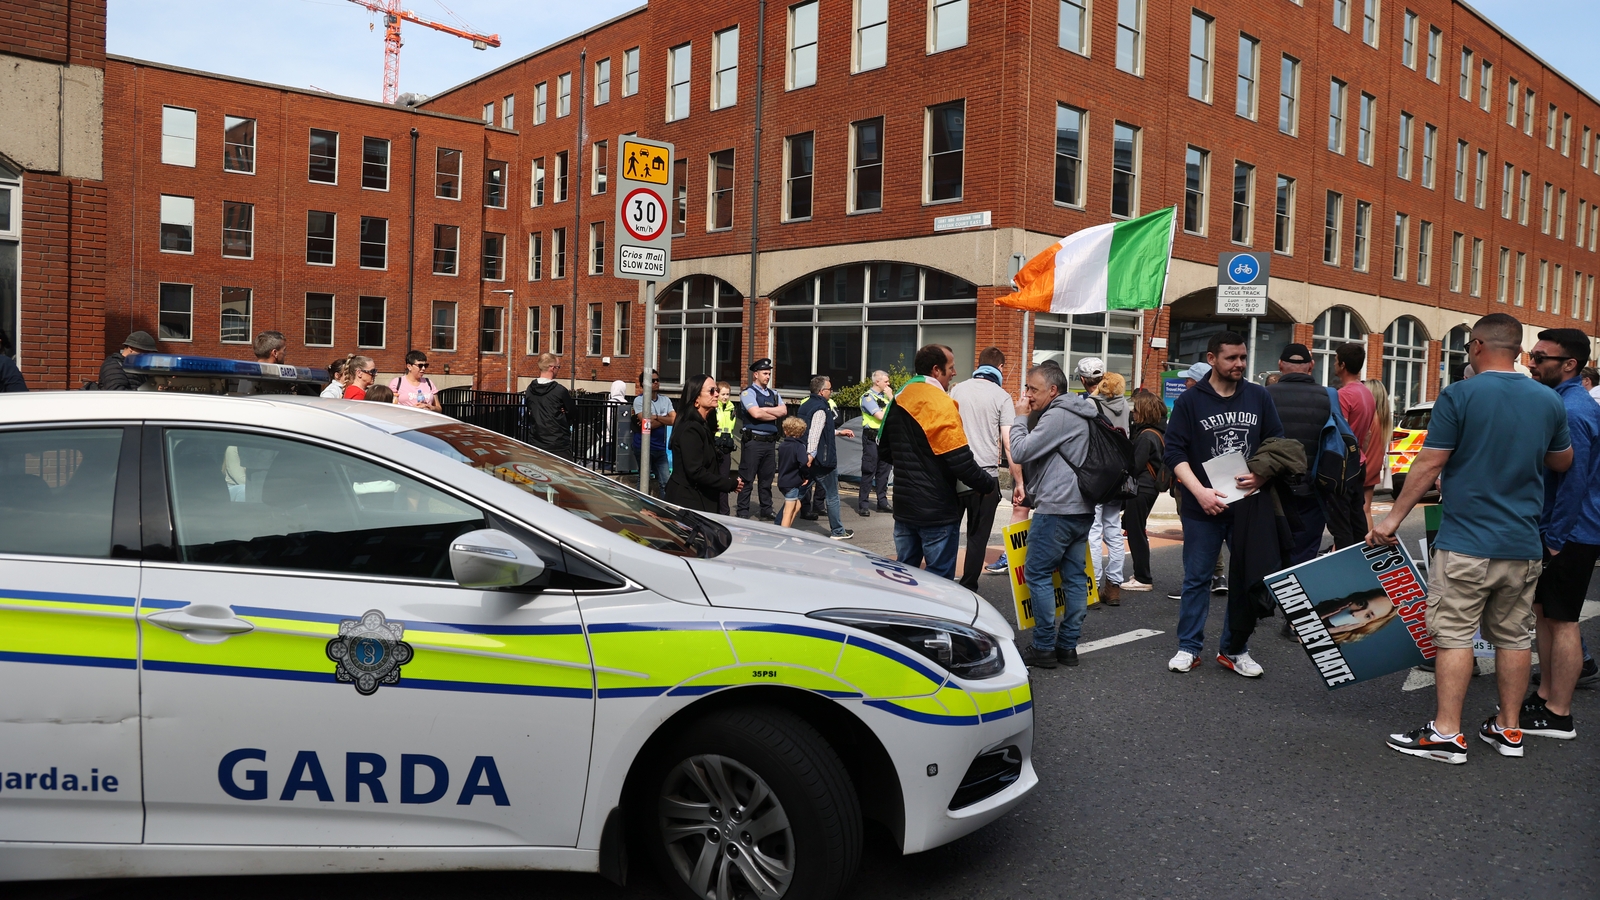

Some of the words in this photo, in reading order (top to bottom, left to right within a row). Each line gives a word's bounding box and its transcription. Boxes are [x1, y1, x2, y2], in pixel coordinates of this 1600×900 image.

[633, 200, 656, 223] 30
[635, 224, 653, 232] km/h
[622, 250, 643, 259] Crios
[646, 252, 663, 261] Mall
[622, 260, 643, 269] SLOW
[644, 262, 663, 271] ZONE
[280, 366, 296, 377] GARDA
[1200, 411, 1258, 430] REDWOOD
[1269, 573, 1314, 615] THAT
[1377, 565, 1428, 608] FREE
[1290, 610, 1335, 650] THEY
[752, 670, 777, 678] 35PSI
[1311, 646, 1356, 688] HATE
[0, 767, 119, 793] arda.ie
[217, 747, 511, 807] GARDA
